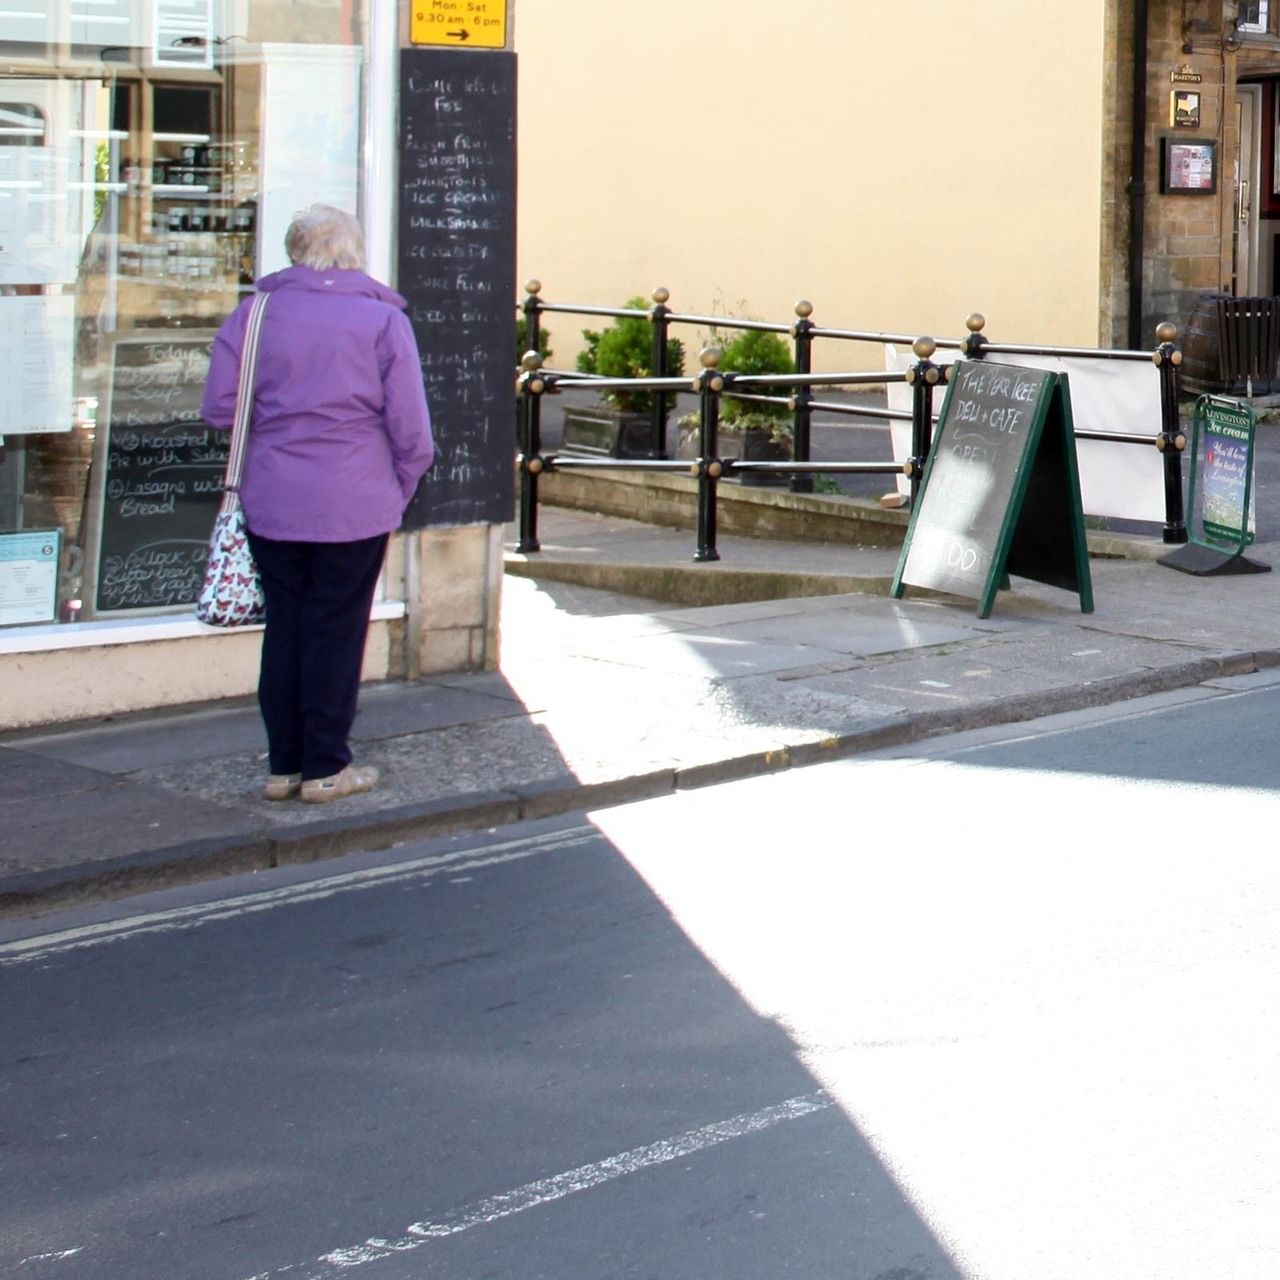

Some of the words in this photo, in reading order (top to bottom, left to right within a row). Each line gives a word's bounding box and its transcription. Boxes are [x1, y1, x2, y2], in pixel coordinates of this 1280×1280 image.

[432, 0, 457, 10] Mon
[467, 2, 486, 12] Sat
[447, 16, 465, 24] am
[483, 18, 501, 26] pm
[956, 400, 980, 421] DELI
[989, 408, 1023, 434] CAFE
[1208, 419, 1222, 433] Ice
[138, 449, 183, 466] with
[193, 475, 226, 492] wit
[120, 495, 175, 517] Bread
